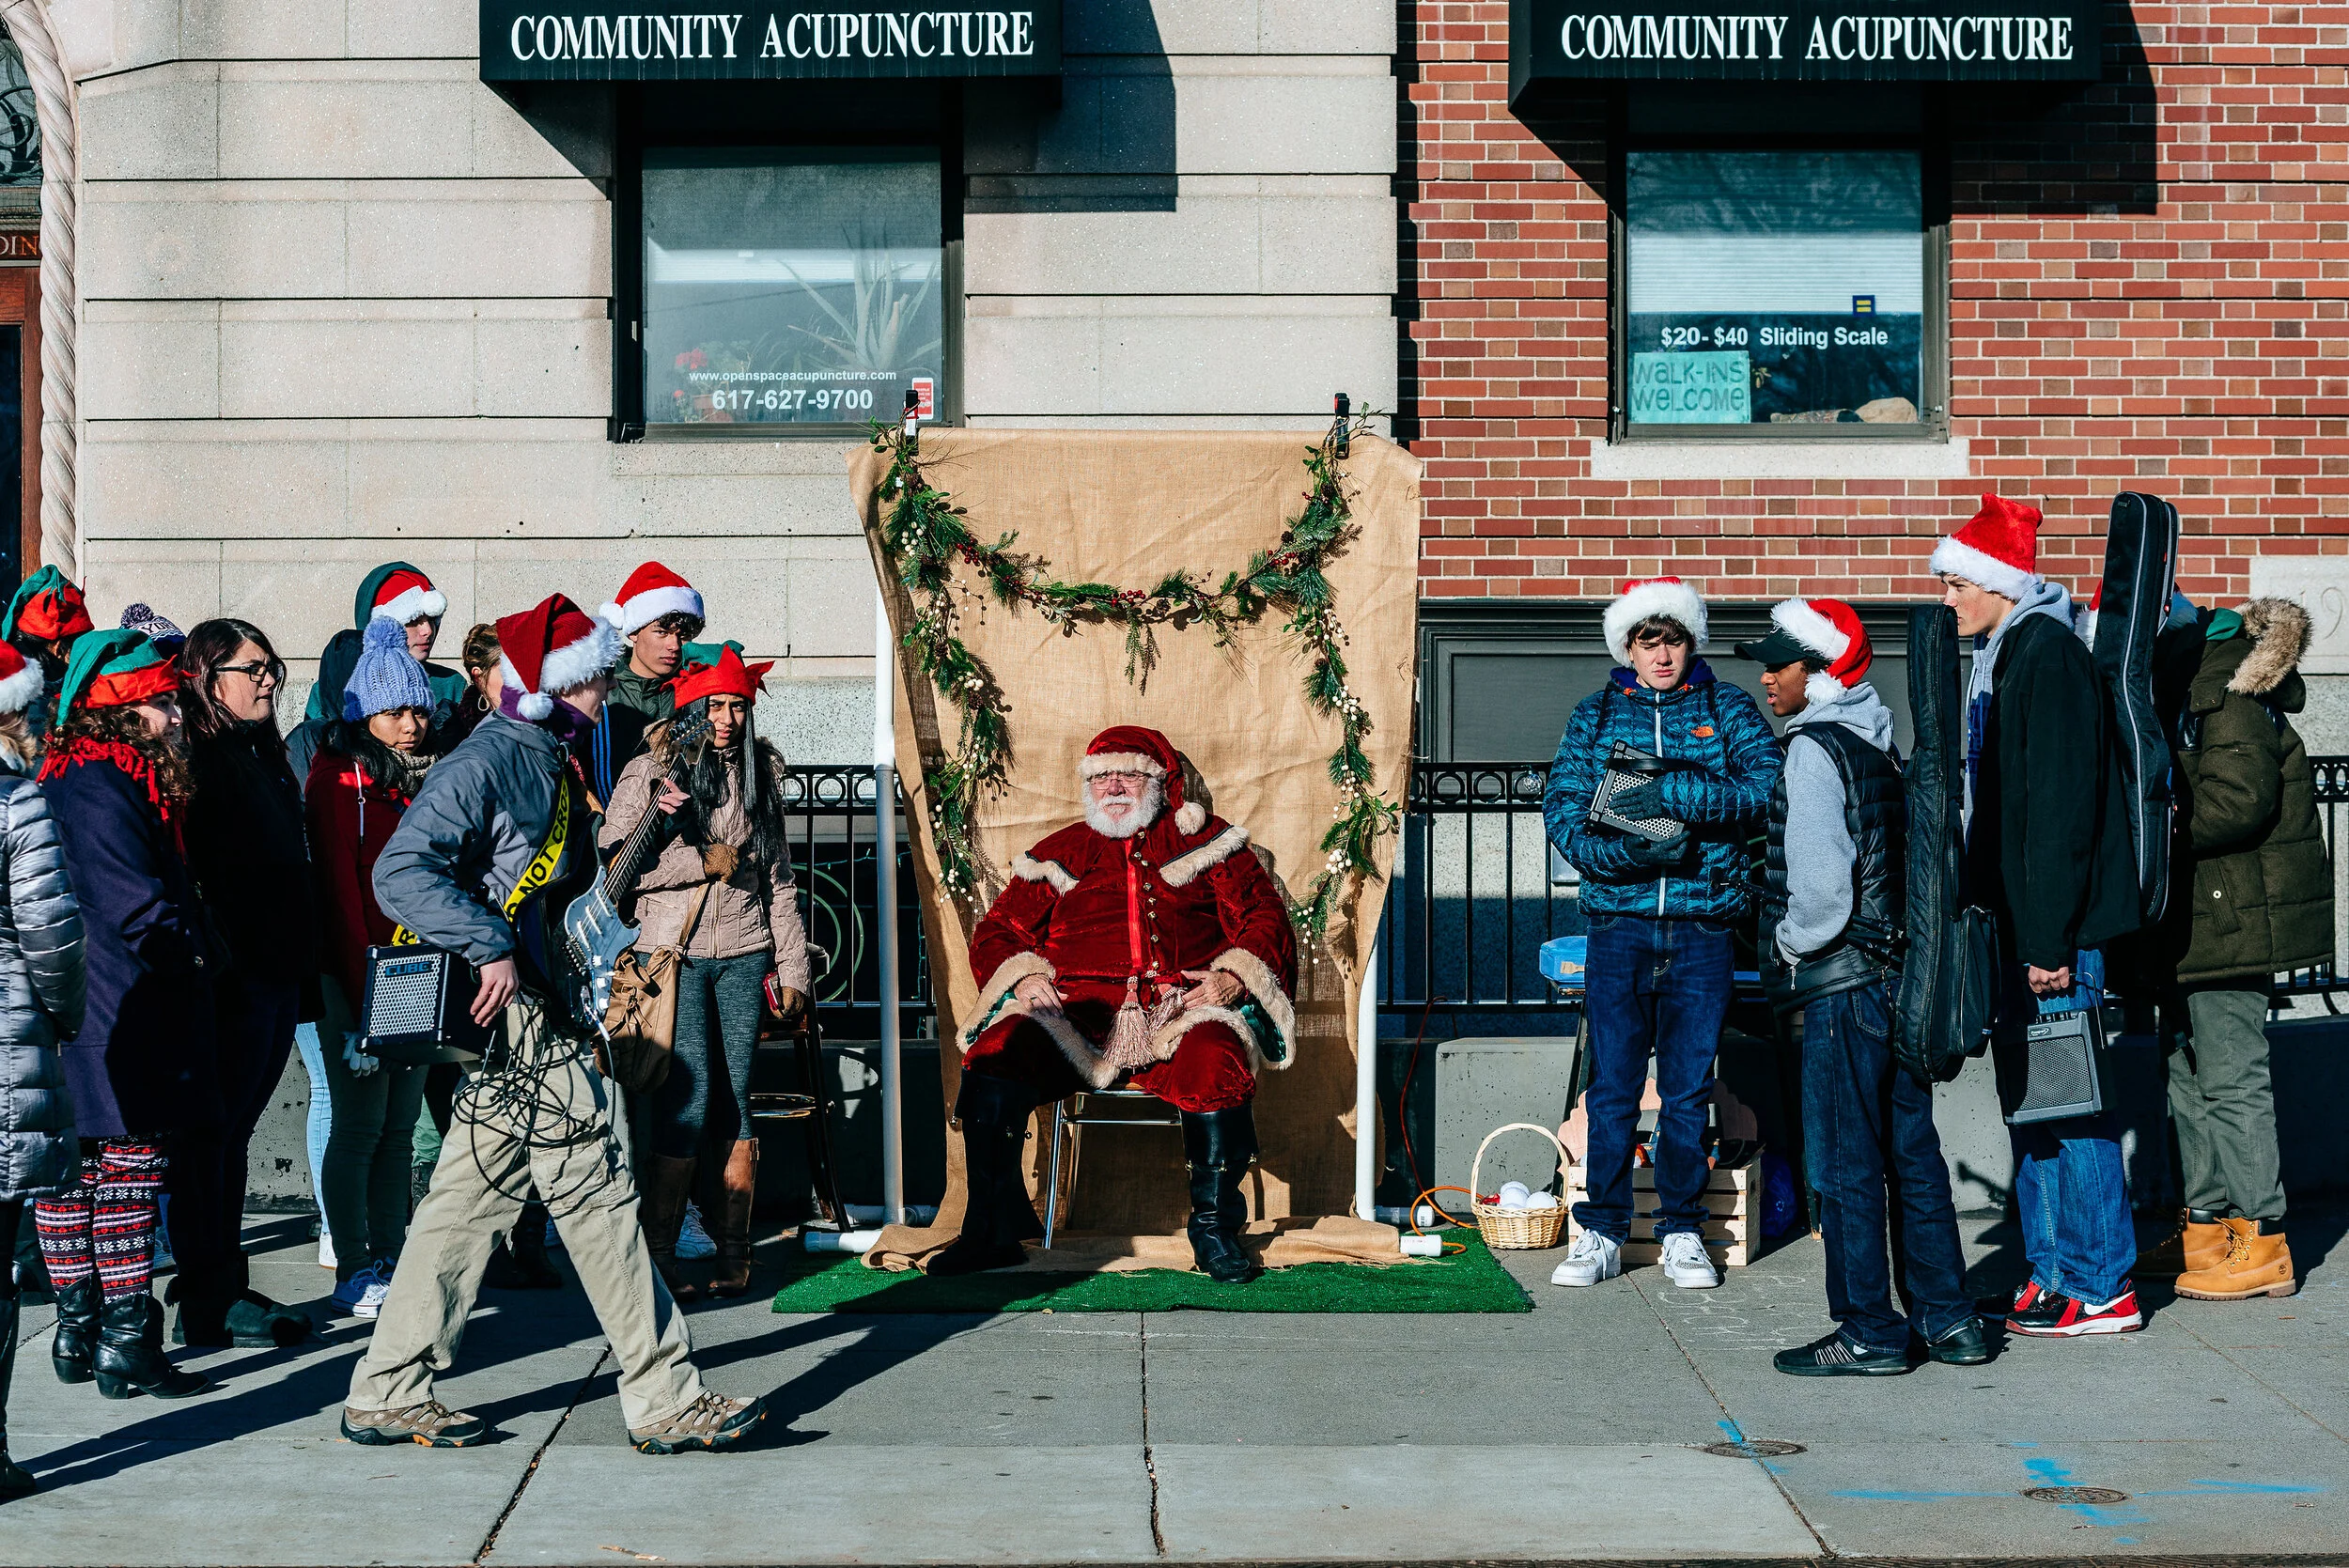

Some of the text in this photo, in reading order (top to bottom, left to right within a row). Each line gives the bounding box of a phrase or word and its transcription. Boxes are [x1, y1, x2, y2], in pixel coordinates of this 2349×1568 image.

[511, 11, 1034, 61] COMMUNITY ACUPUNCTURE
[1561, 14, 2074, 61] COMMUNITY ACUPUNCTURE
[1759, 327, 1828, 349] Sliding
[1834, 326, 1889, 346] Scale
[689, 370, 897, 382] www.openspaceacupuncture.com
[711, 389, 874, 411] 617-627-9700
[518, 845, 554, 894] NOT
[385, 961, 430, 976] CUBE
